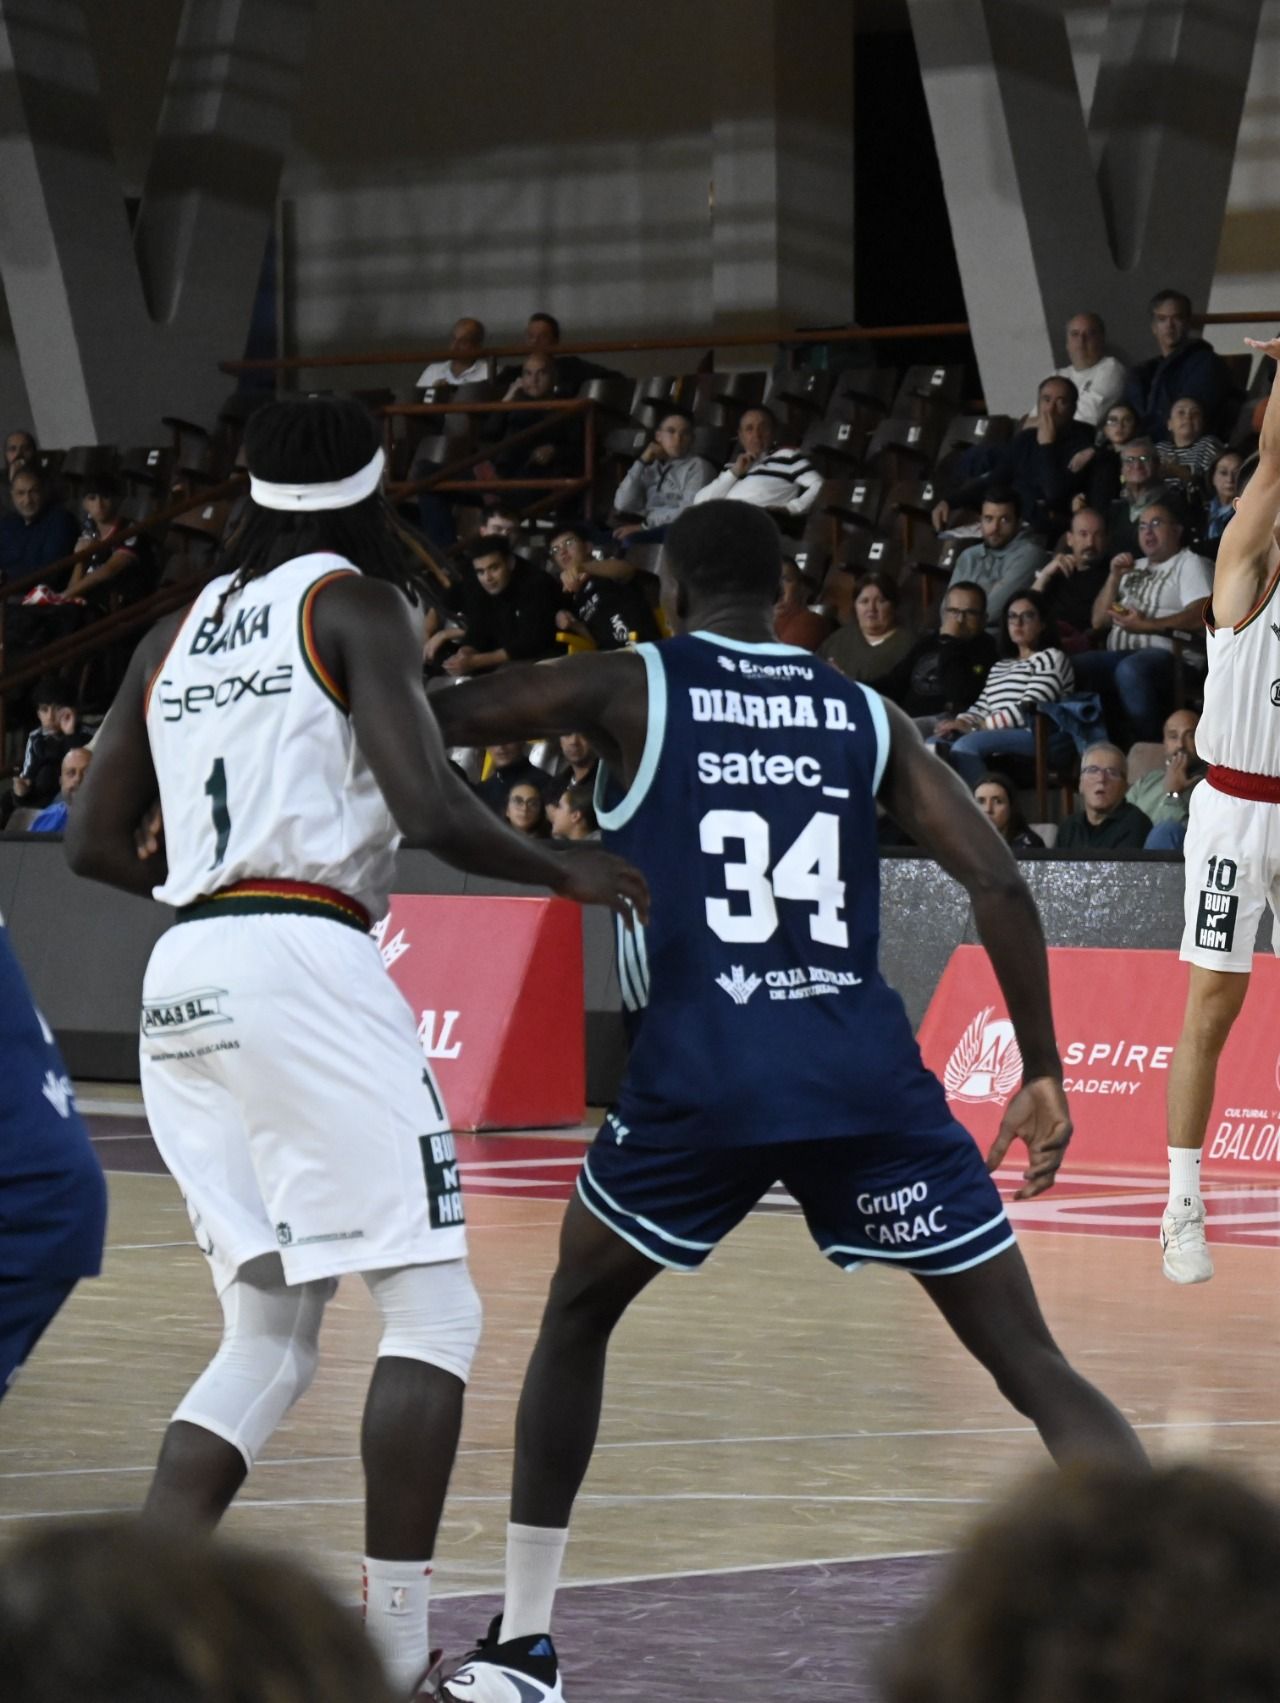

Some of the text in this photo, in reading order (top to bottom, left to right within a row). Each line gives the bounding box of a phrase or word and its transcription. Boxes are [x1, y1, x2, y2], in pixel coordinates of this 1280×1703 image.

[688, 687, 857, 732] DIARRA D.
[204, 757, 231, 871] 1
[699, 809, 849, 948] 34
[1206, 855, 1237, 892] 10
[1204, 892, 1231, 913] BUN
[1199, 928, 1227, 949] HAM
[765, 968, 807, 987] CAJA
[1063, 1040, 1174, 1073] SPIRE
[422, 1067, 443, 1121] 1
[1062, 1078, 1141, 1095] CADEMY
[1224, 1108, 1268, 1119] CULTURAL
[430, 1133, 456, 1164] BU
[438, 1190, 464, 1223] HA
[857, 1181, 928, 1215] Grupo
